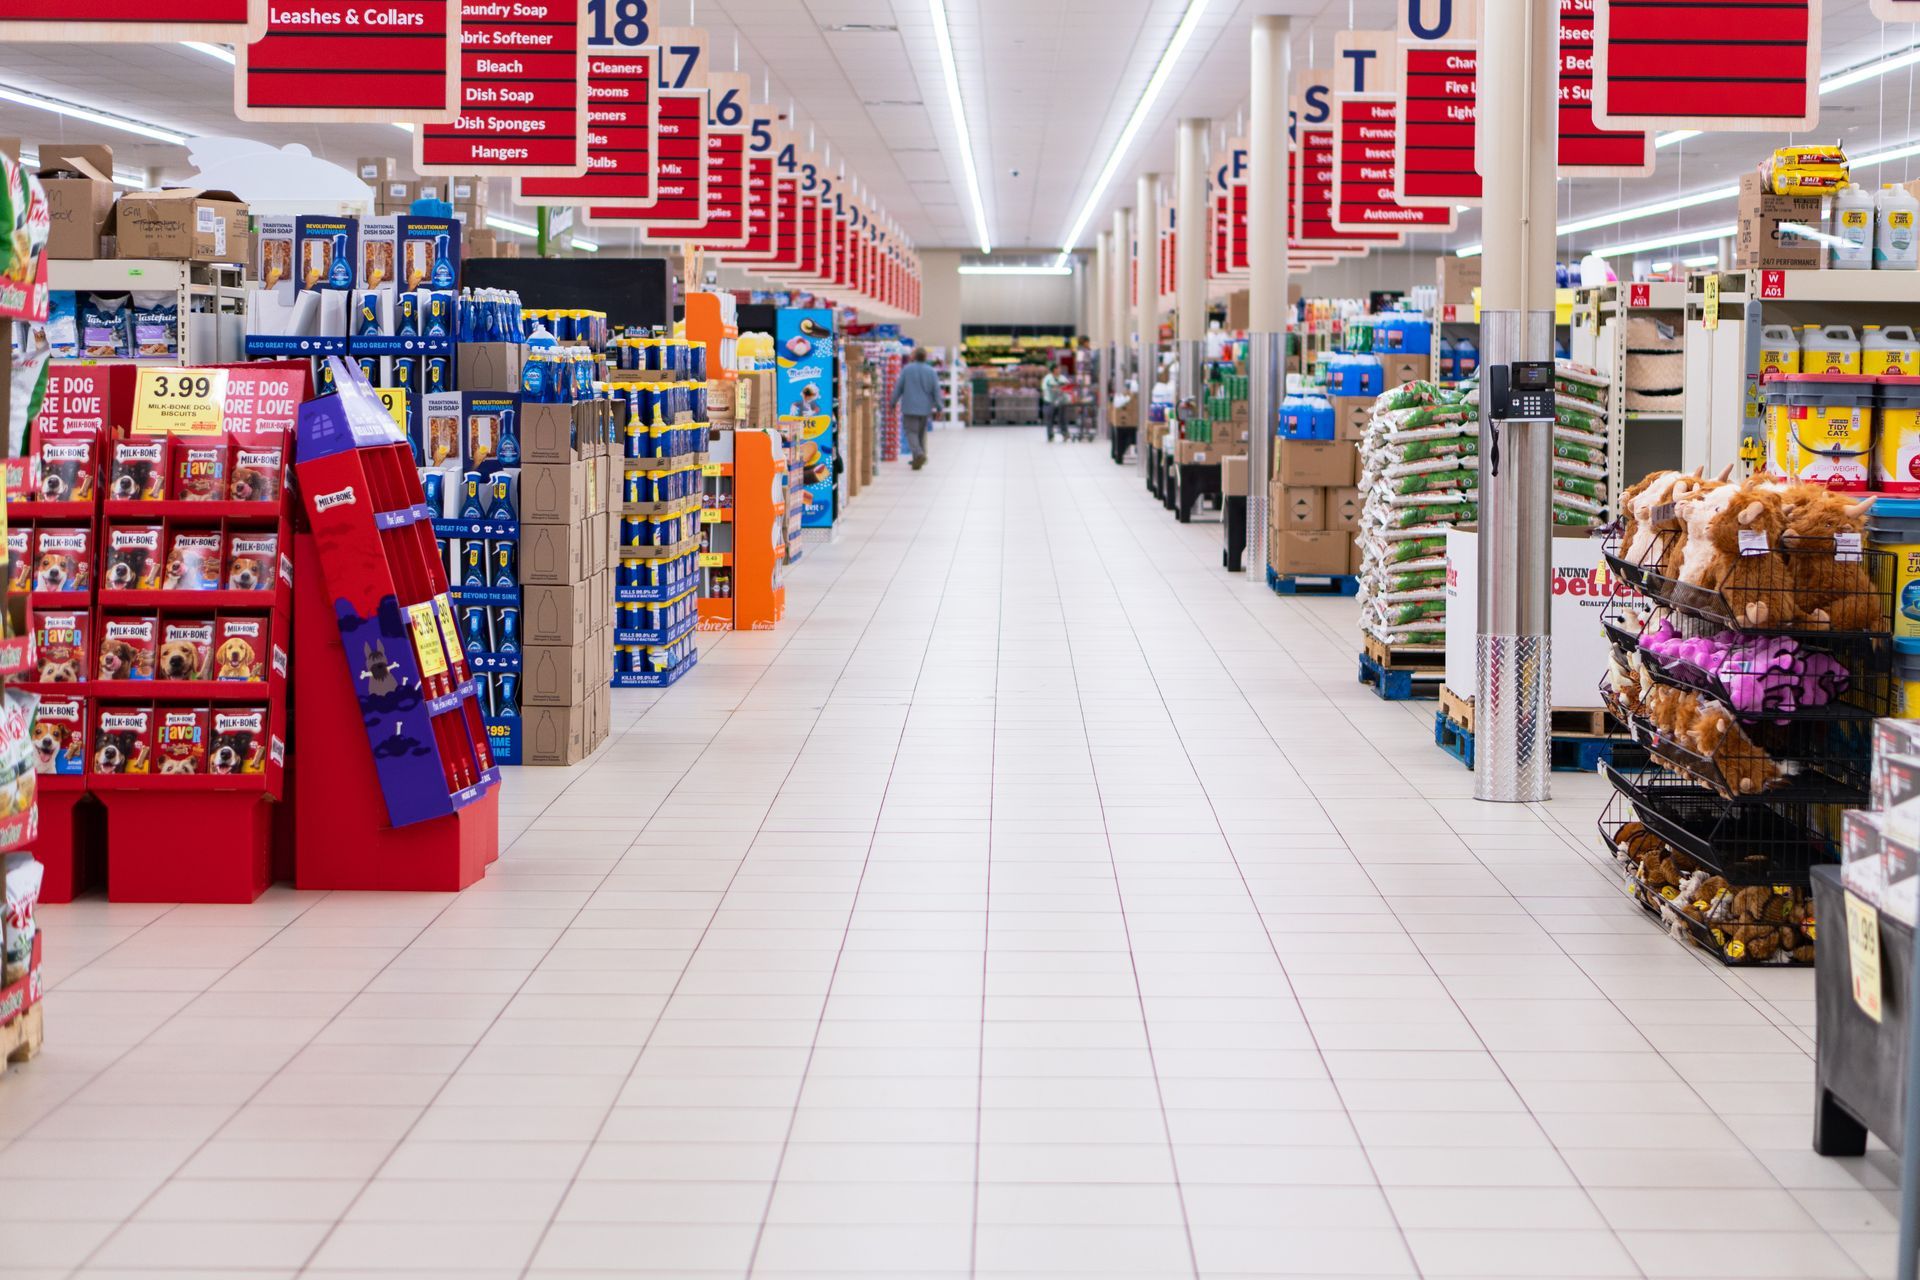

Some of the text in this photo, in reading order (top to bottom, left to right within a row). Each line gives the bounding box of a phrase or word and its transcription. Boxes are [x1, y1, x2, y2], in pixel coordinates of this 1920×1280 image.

[460, 3, 547, 18] aundry Soap
[270, 8, 424, 26] Leashes & Collars
[1408, 0, 1452, 40] U
[588, 0, 649, 46] 18
[460, 32, 552, 44] abric Softener
[477, 60, 523, 72] Bleach
[592, 62, 642, 73] Cleaners
[1446, 57, 1476, 68] Char
[1567, 56, 1593, 69] Bed
[1343, 50, 1376, 92] T
[1445, 81, 1468, 93] Fire
[466, 88, 534, 103] Dish Soap
[1304, 85, 1330, 123] S
[588, 111, 627, 122] peners
[1372, 107, 1396, 118] Hard
[1447, 106, 1476, 119] Light
[455, 117, 546, 132] Dish Sponges
[659, 125, 679, 133] ters
[1360, 128, 1396, 137] Furnac
[587, 134, 608, 144] dles
[472, 145, 528, 159] Hangers
[1366, 148, 1396, 158] Insect
[587, 157, 617, 167] Bulbs
[662, 164, 683, 174] Mix
[1361, 168, 1386, 178] Plant
[659, 186, 685, 195] amer
[708, 209, 731, 218] pplies
[1364, 209, 1423, 220] Automotive
[1776, 258, 1817, 266] PERFORMANCE
[1768, 274, 1780, 283] W
[1764, 288, 1782, 296] A01
[64, 379, 95, 394] DOG
[154, 376, 210, 397] 3.99
[229, 380, 289, 396] ORE DOG
[43, 397, 101, 414] RE LOVE
[224, 399, 294, 415] ORE LOVE
[381, 394, 394, 411] 9
[40, 417, 59, 433] RE
[223, 417, 250, 433] ORE
[47, 446, 86, 459] MILK-BONE
[120, 446, 157, 458] MILK-BONE
[190, 451, 216, 459] MILK-BONE
[240, 455, 279, 465] MILK-BONE
[319, 490, 353, 507] MILK-BONE
[43, 538, 84, 549] MILK-BONE
[116, 535, 154, 546] MILK-BONE
[178, 538, 217, 548] MILK-BONE
[236, 542, 274, 552] MILK-BONE
[1559, 567, 1589, 578] NUNN
[110, 626, 149, 638] MILK-BONE
[170, 629, 209, 641] MILK-BONE
[228, 625, 257, 634] MILK-BONE
[105, 717, 144, 728] MILK-BONE
[168, 716, 194, 724] MILK-BONE
[219, 718, 259, 729] MILK-BONE
